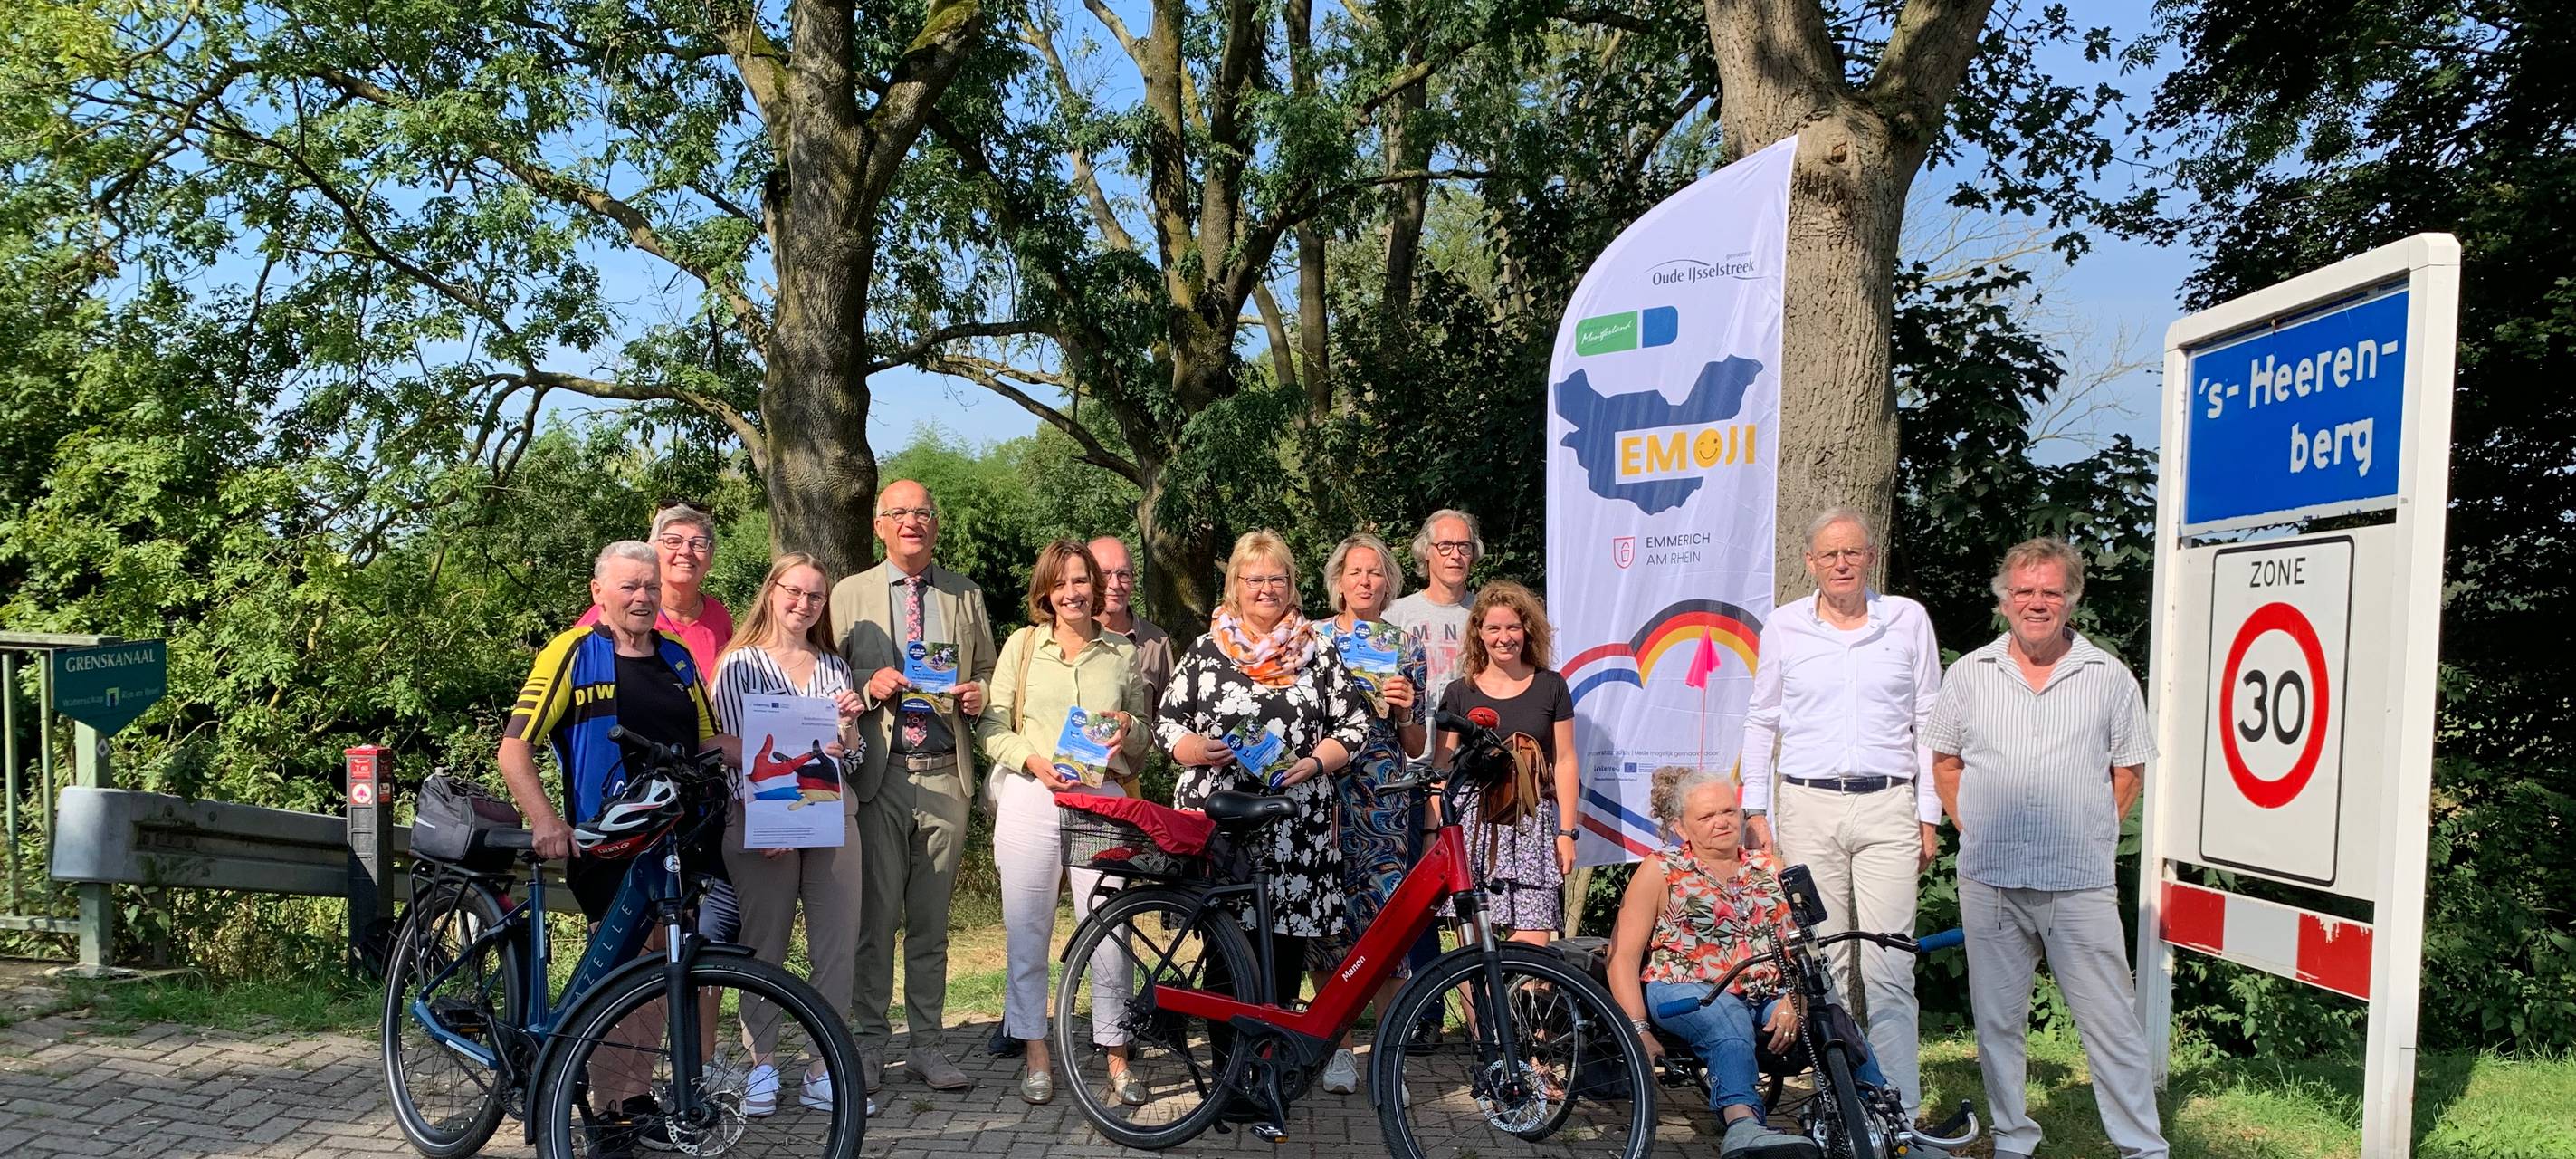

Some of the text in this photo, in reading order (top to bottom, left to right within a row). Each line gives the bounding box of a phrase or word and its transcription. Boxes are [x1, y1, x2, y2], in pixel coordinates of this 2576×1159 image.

[1653, 257, 1755, 285] Oude IJsselstreek
[1621, 424, 1757, 476] EMOJI
[2290, 417, 2374, 478] berg
[1646, 532, 1711, 548] EMMERICH
[1646, 551, 1701, 566] AM RHEIN
[2249, 557, 2306, 588] ZONE
[65, 648, 156, 672] GRENSKANAAL
[2237, 669, 2306, 746] 30
[1341, 955, 1366, 982] Manon
